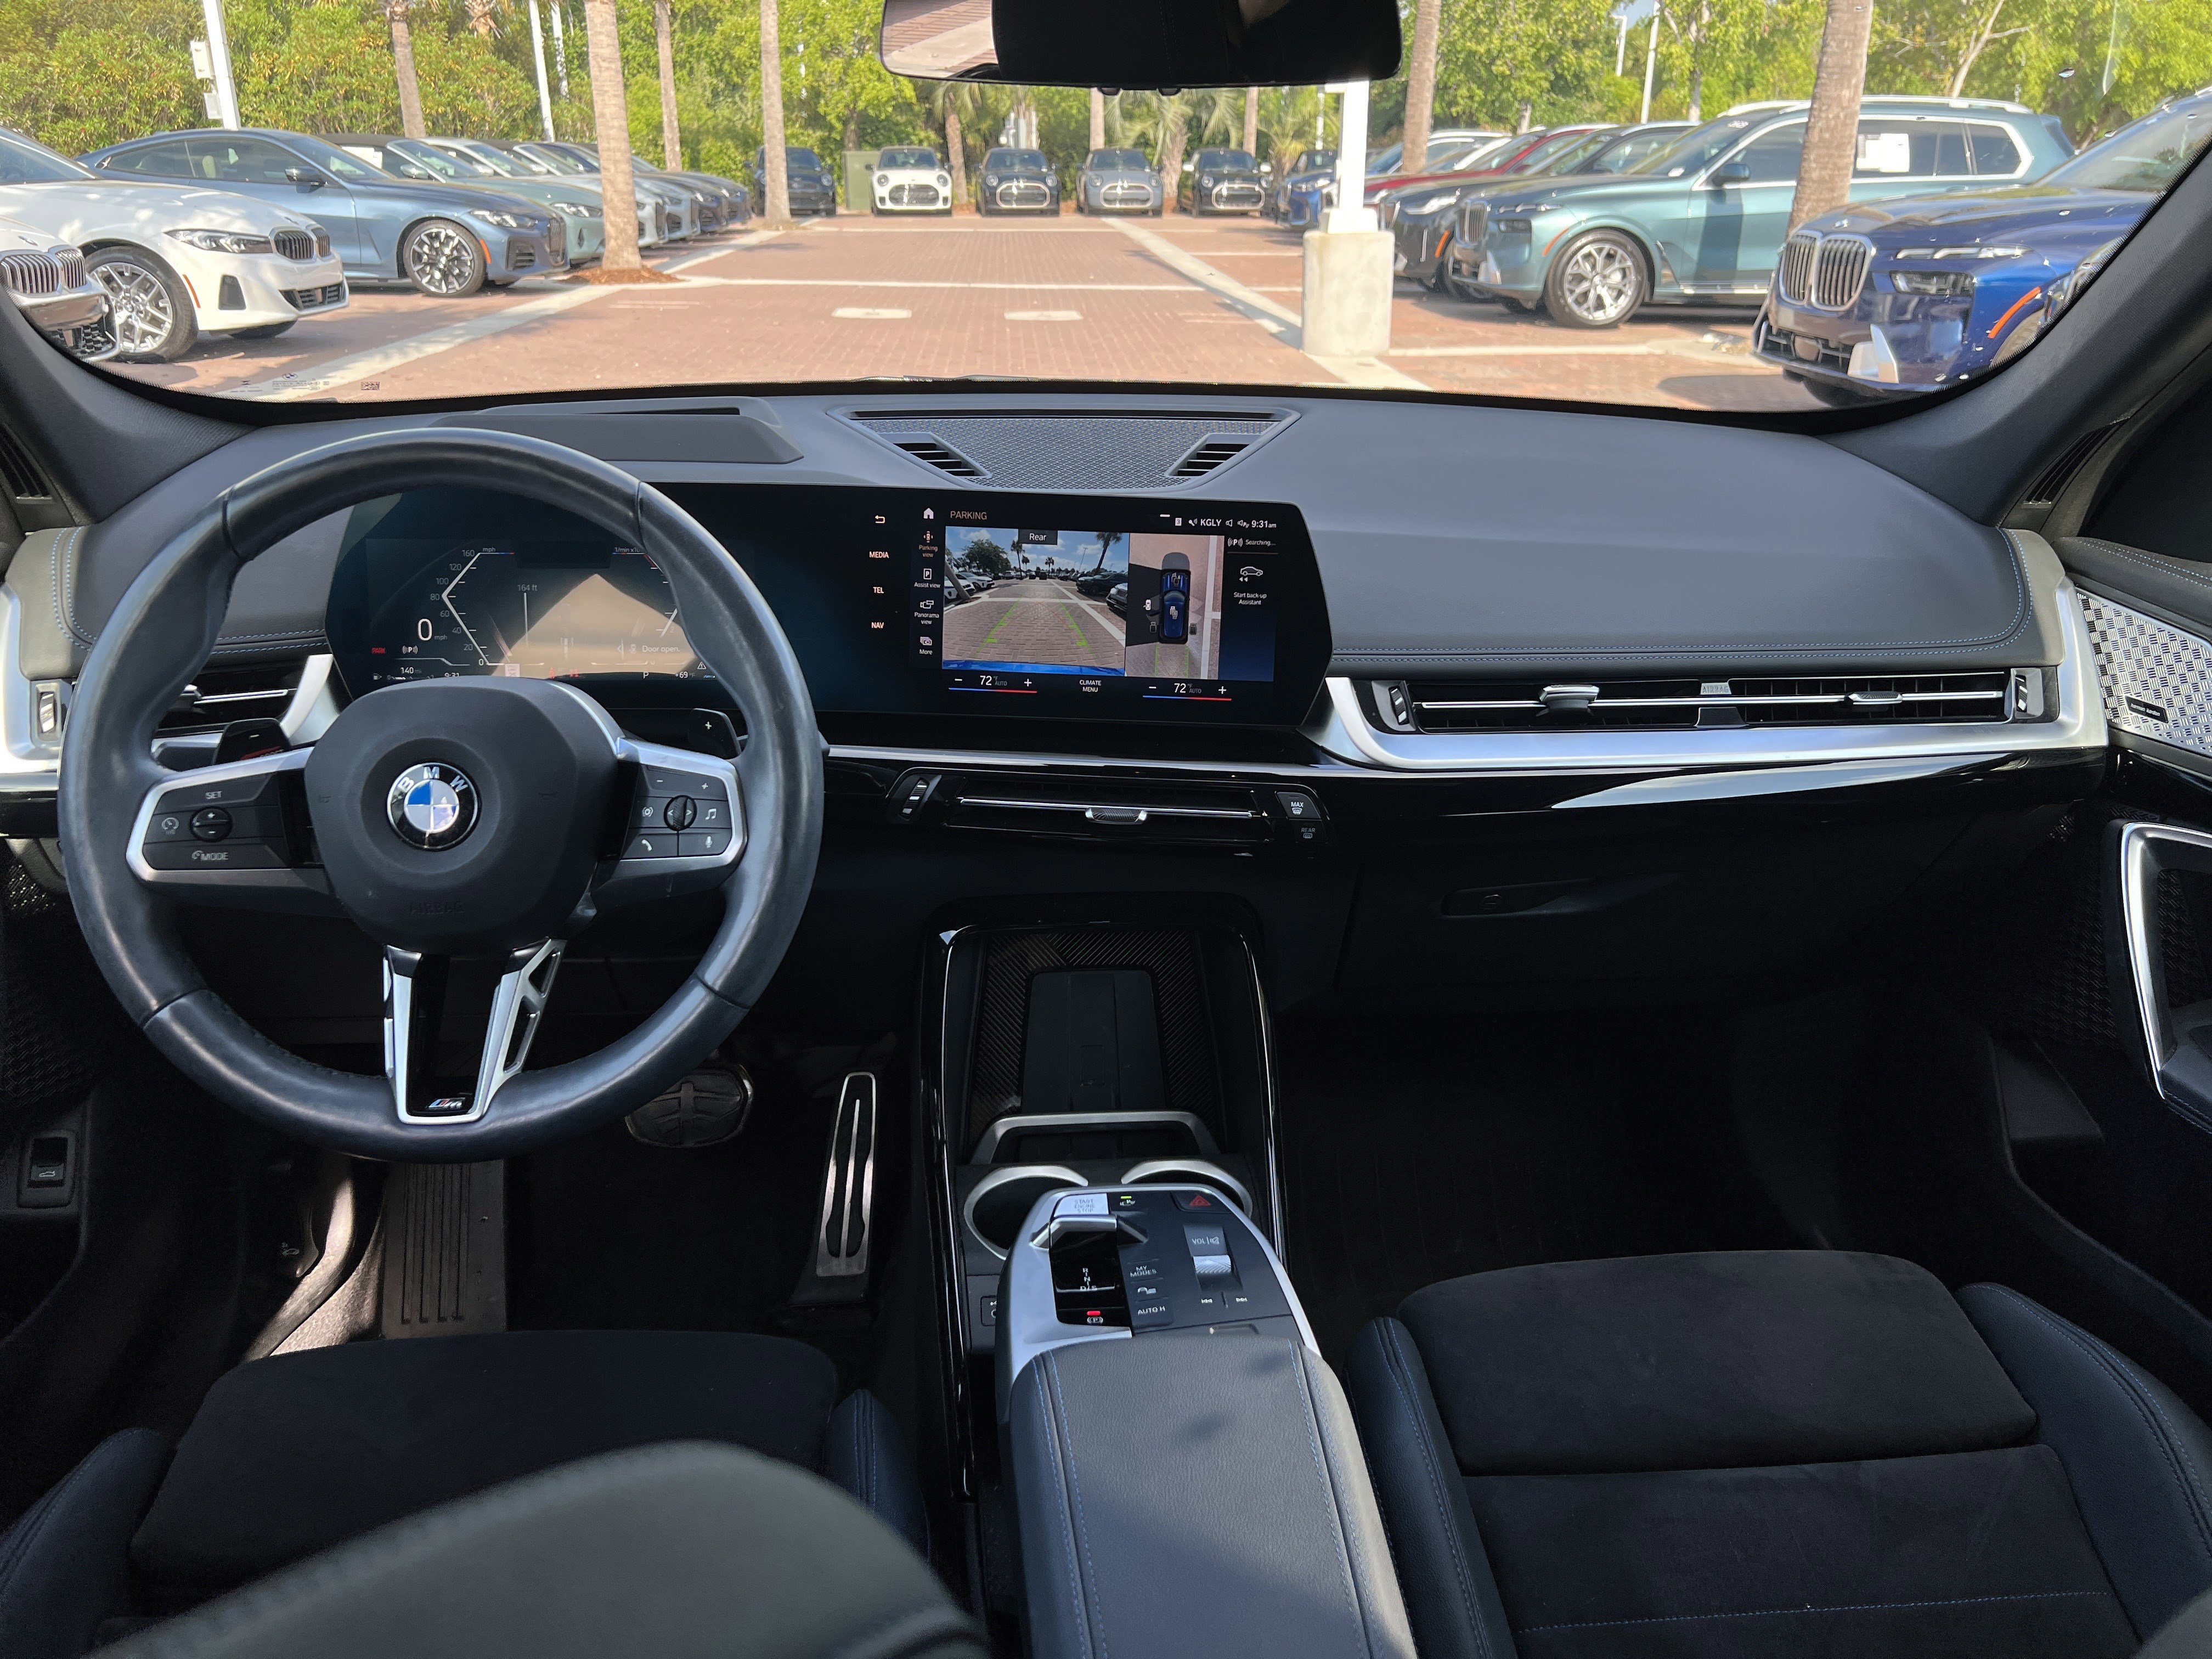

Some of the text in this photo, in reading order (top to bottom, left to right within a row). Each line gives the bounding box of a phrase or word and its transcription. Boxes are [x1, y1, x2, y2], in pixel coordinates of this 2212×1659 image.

[950, 510, 988, 521] PARKING
[1200, 518, 1222, 527] KGLY
[1029, 533, 1047, 541] Rear
[869, 551, 889, 559] MEDIA
[517, 584, 530, 592] 164
[417, 618, 433, 641] 0
[871, 622, 884, 630] NAV
[400, 666, 414, 674] 140
[979, 675, 992, 686] 72
[1174, 682, 1186, 693] 72
[1702, 684, 1729, 693] AIRBAG
[396, 765, 469, 792] BMW
[205, 790, 222, 799] SET
[201, 851, 229, 861] MODE
[1130, 1269, 1157, 1277] MODES
[1137, 1307, 1158, 1316] AUTO
